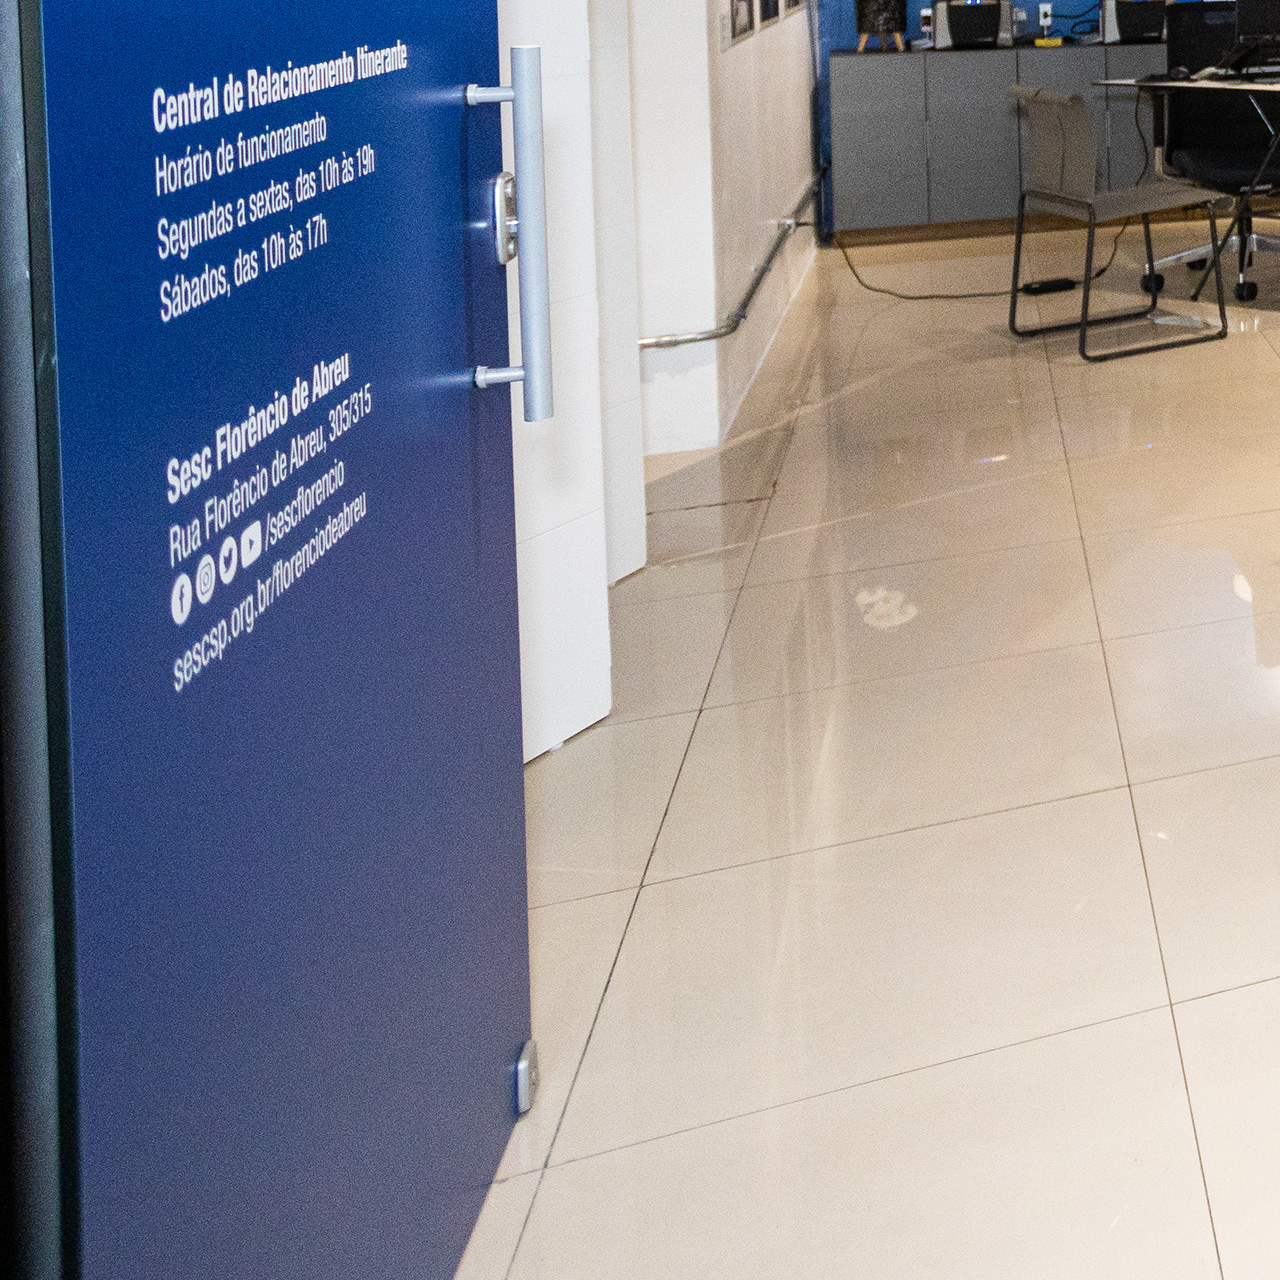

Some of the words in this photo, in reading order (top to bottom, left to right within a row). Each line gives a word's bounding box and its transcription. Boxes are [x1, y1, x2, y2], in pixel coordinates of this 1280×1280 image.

[152, 76, 219, 133] Central
[223, 73, 244, 115] de
[247, 50, 355, 109] Relacionamento
[356, 39, 408, 80] Itinerante
[155, 144, 213, 197] Horário
[216, 138, 235, 176] de
[236, 111, 327, 169] funcionamento
[157, 200, 234, 260] Segundas
[236, 197, 247, 228] a
[248, 181, 293, 222] sextas,
[295, 170, 317, 203] das
[318, 159, 340, 193] 10h
[341, 151, 355, 184] às
[355, 143, 375, 177] 19h
[159, 263, 231, 322] Sábados,
[233, 250, 259, 287] das
[261, 231, 286, 272] 10h
[288, 224, 304, 261] às
[305, 213, 328, 251] 17h
[166, 446, 212, 504] Sesc
[215, 390, 289, 471] Florêncio
[291, 376, 309, 417] de
[311, 352, 350, 403] Abreu
[169, 518, 202, 569] Rua
[204, 467, 269, 540] Florêncio
[271, 456, 288, 488] de
[289, 430, 327, 475] Abreu,
[328, 383, 372, 442] 305/315
